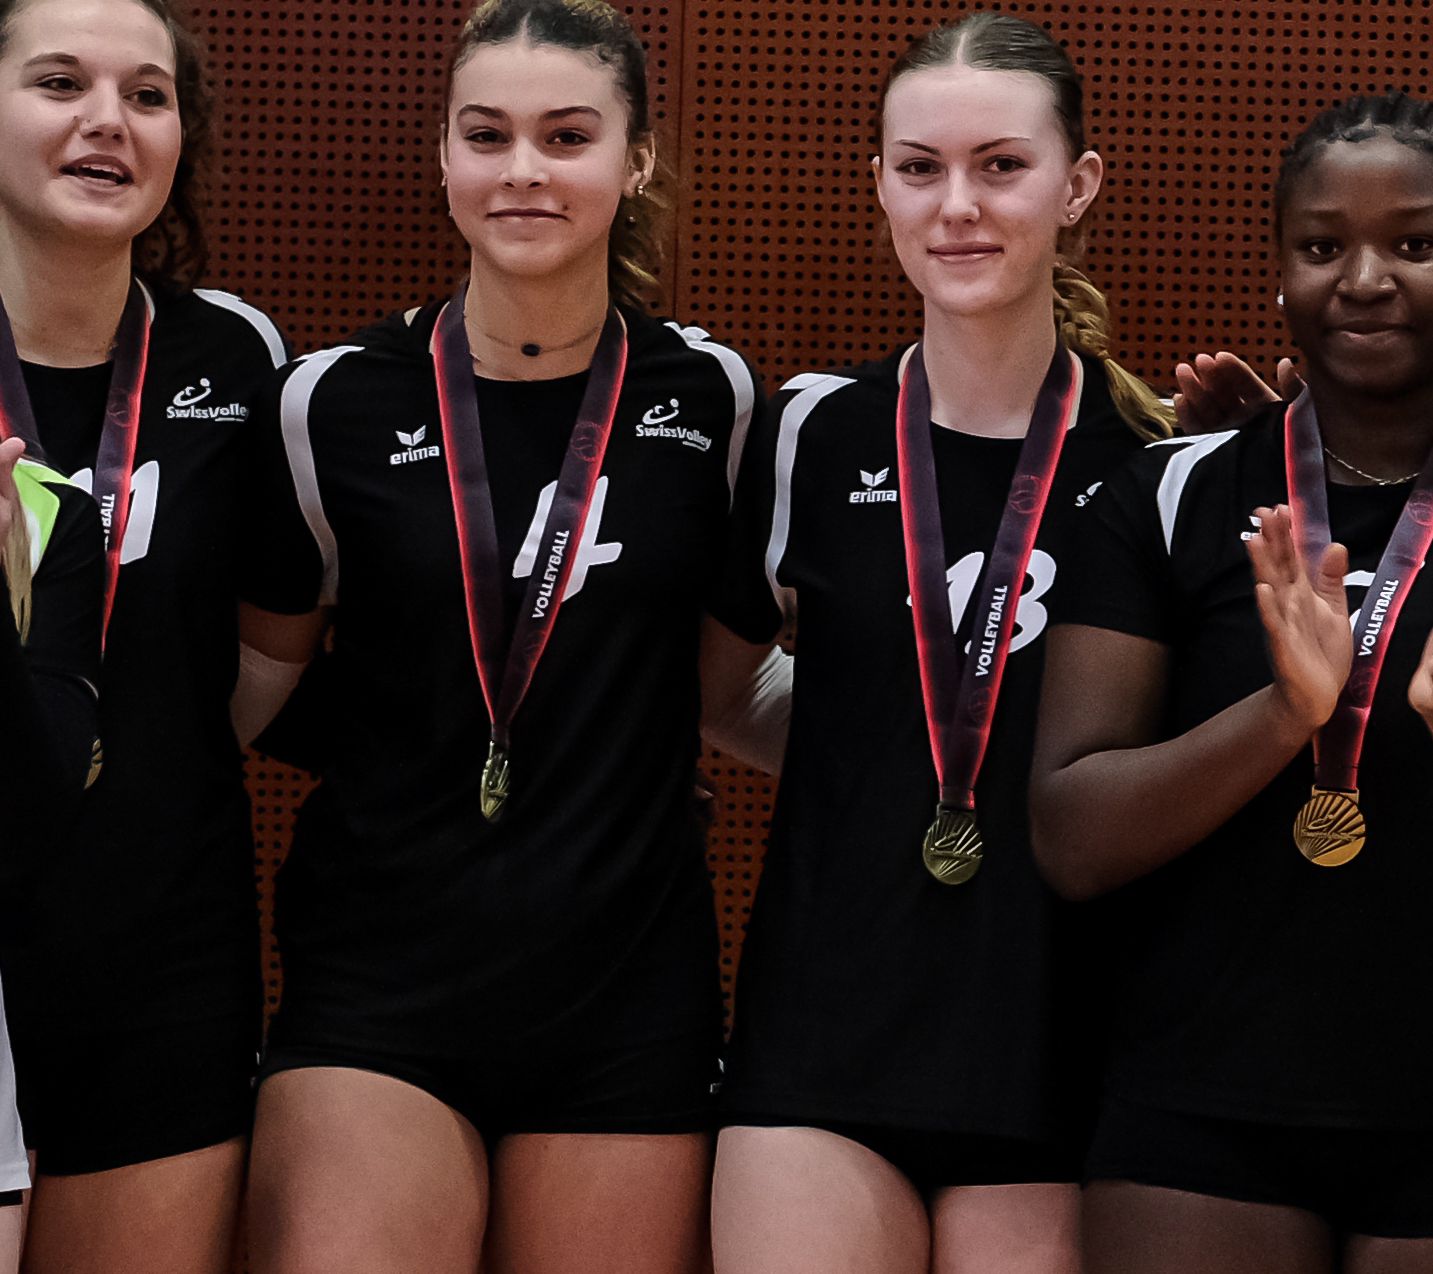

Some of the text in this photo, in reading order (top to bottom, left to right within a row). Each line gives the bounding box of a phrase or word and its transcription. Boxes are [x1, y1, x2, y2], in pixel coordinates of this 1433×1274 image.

[165, 402, 249, 420] SwissVolle
[389, 445, 440, 465] erima
[848, 488, 898, 503] erima
[531, 529, 570, 619] VOLLEYBALL
[975, 585, 1008, 677] VOLLEYBALL
[1357, 579, 1399, 657] VOLLEYBALL
